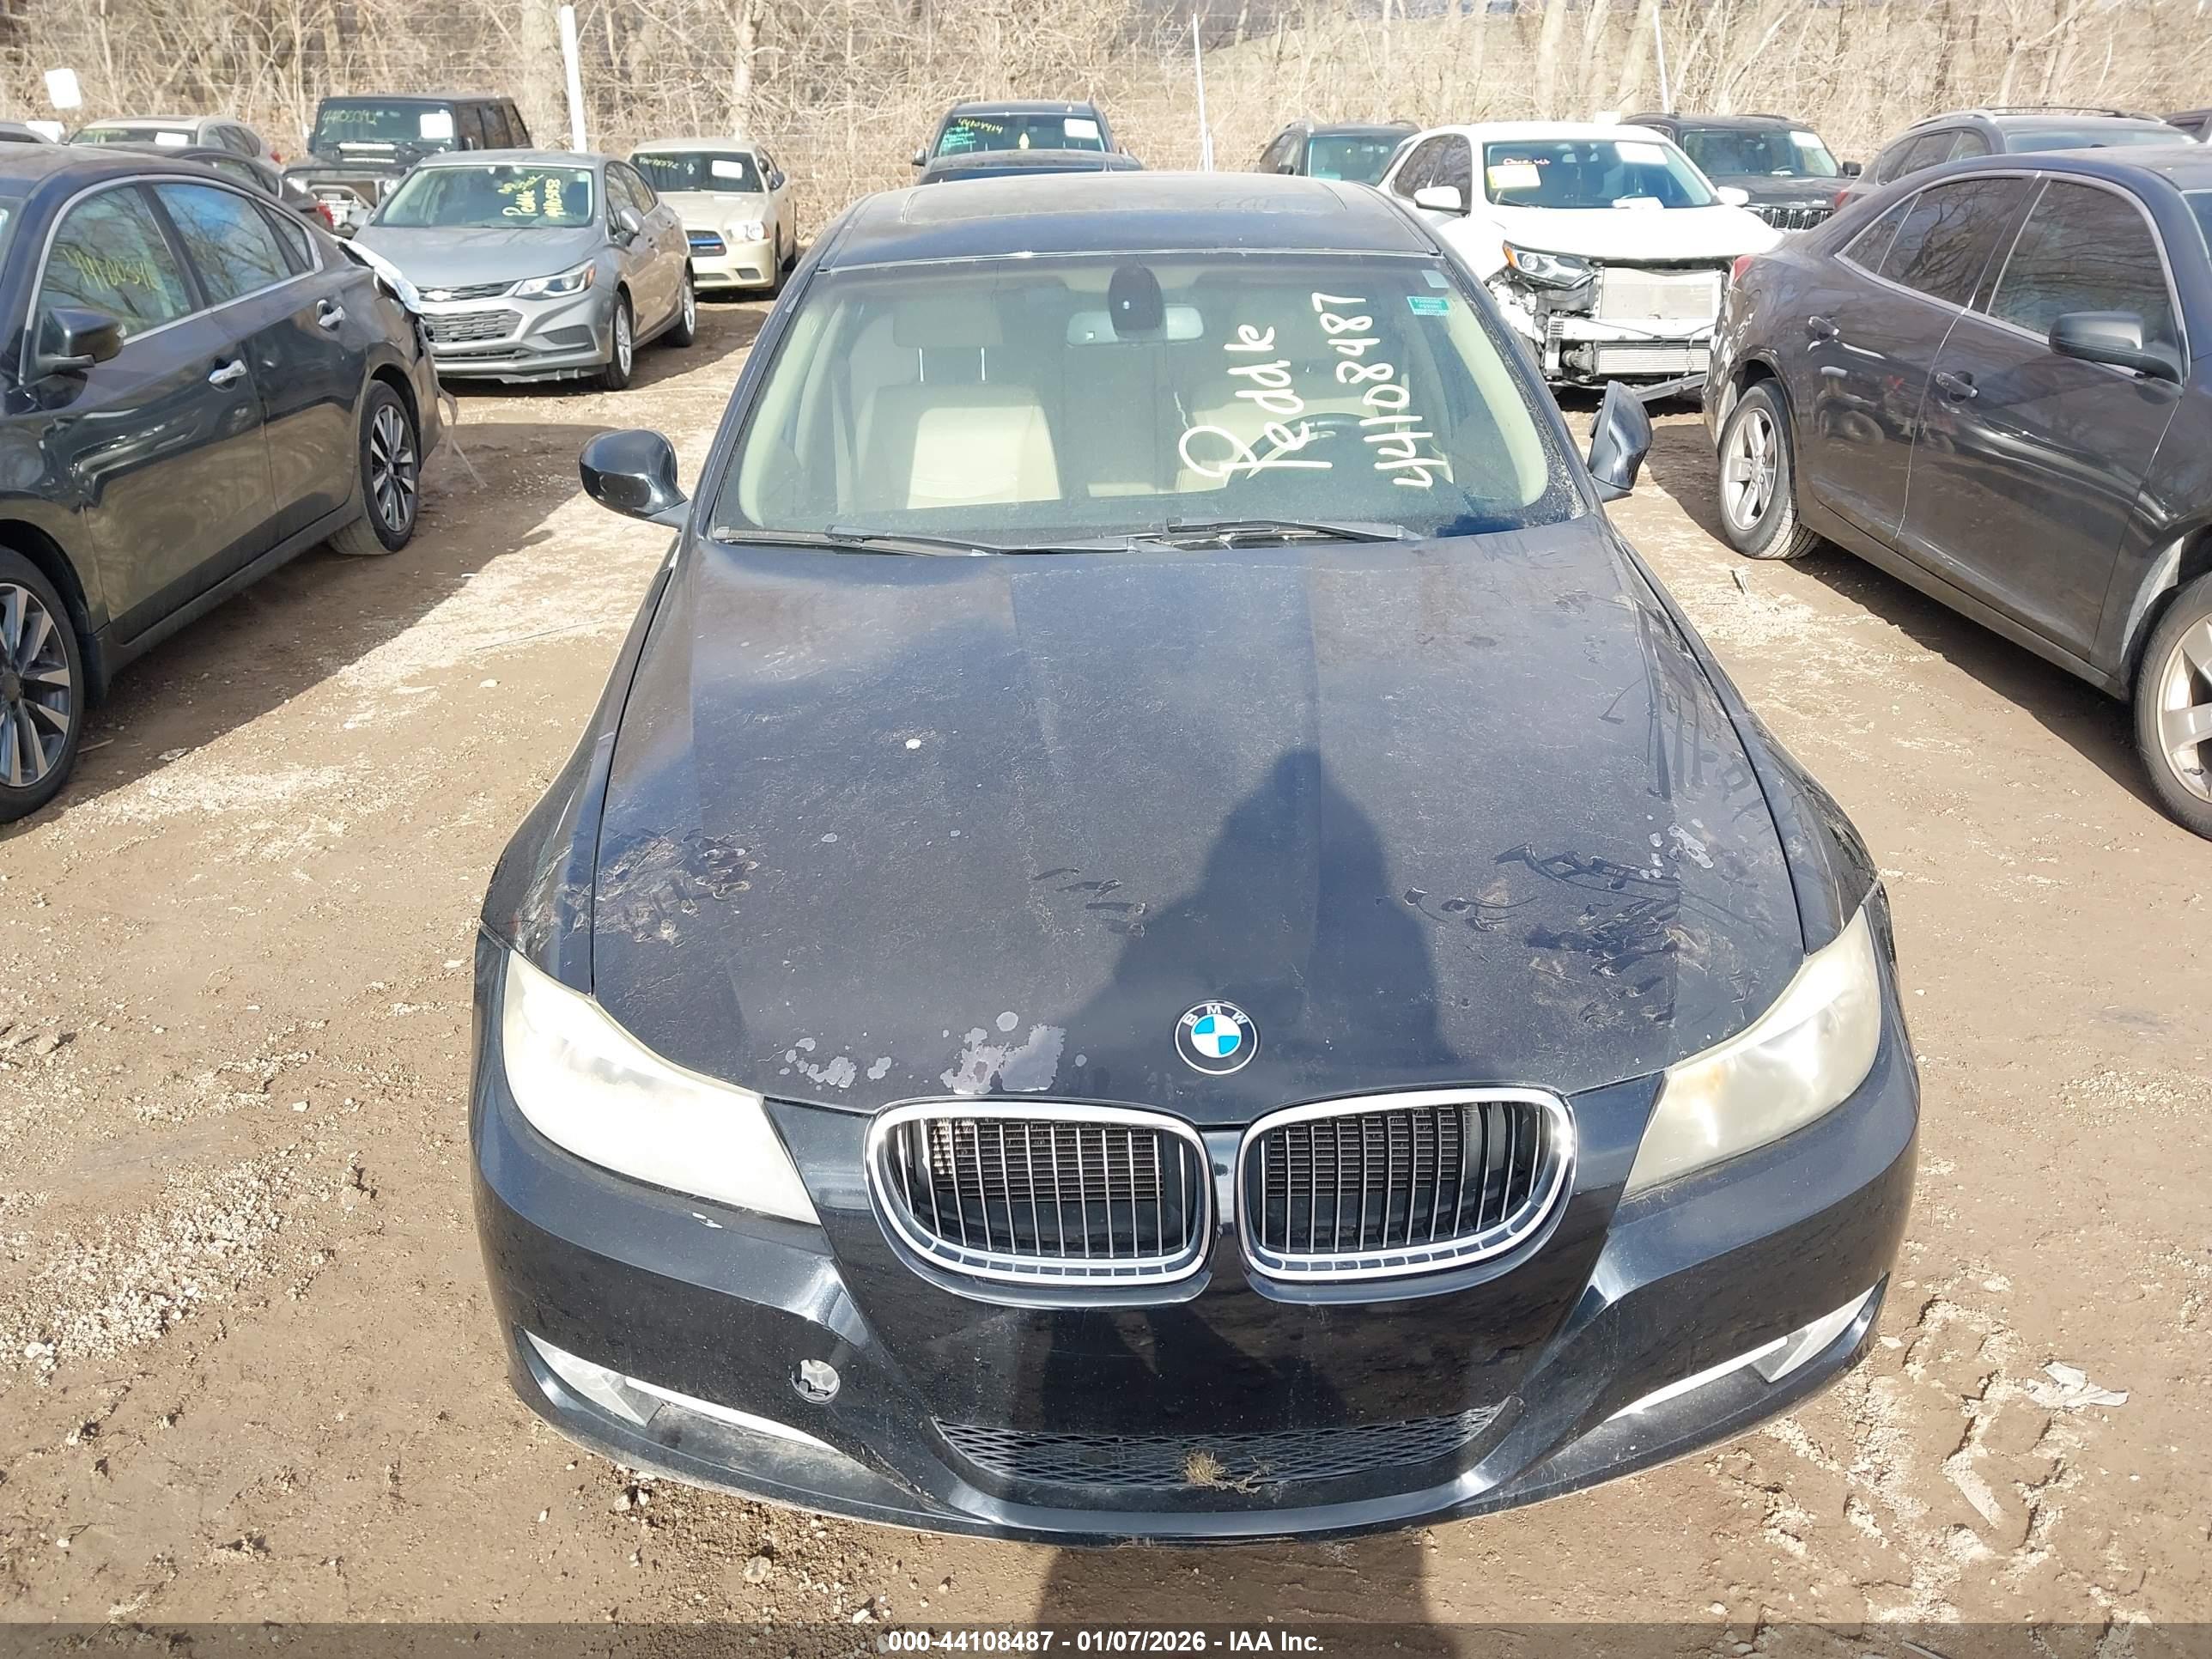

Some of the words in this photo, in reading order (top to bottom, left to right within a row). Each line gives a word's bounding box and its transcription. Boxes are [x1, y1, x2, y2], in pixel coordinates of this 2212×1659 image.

[1178, 324, 1333, 477] Peddle
[1311, 292, 1448, 488] 44108487
[1182, 1005, 1249, 1026] BMW
